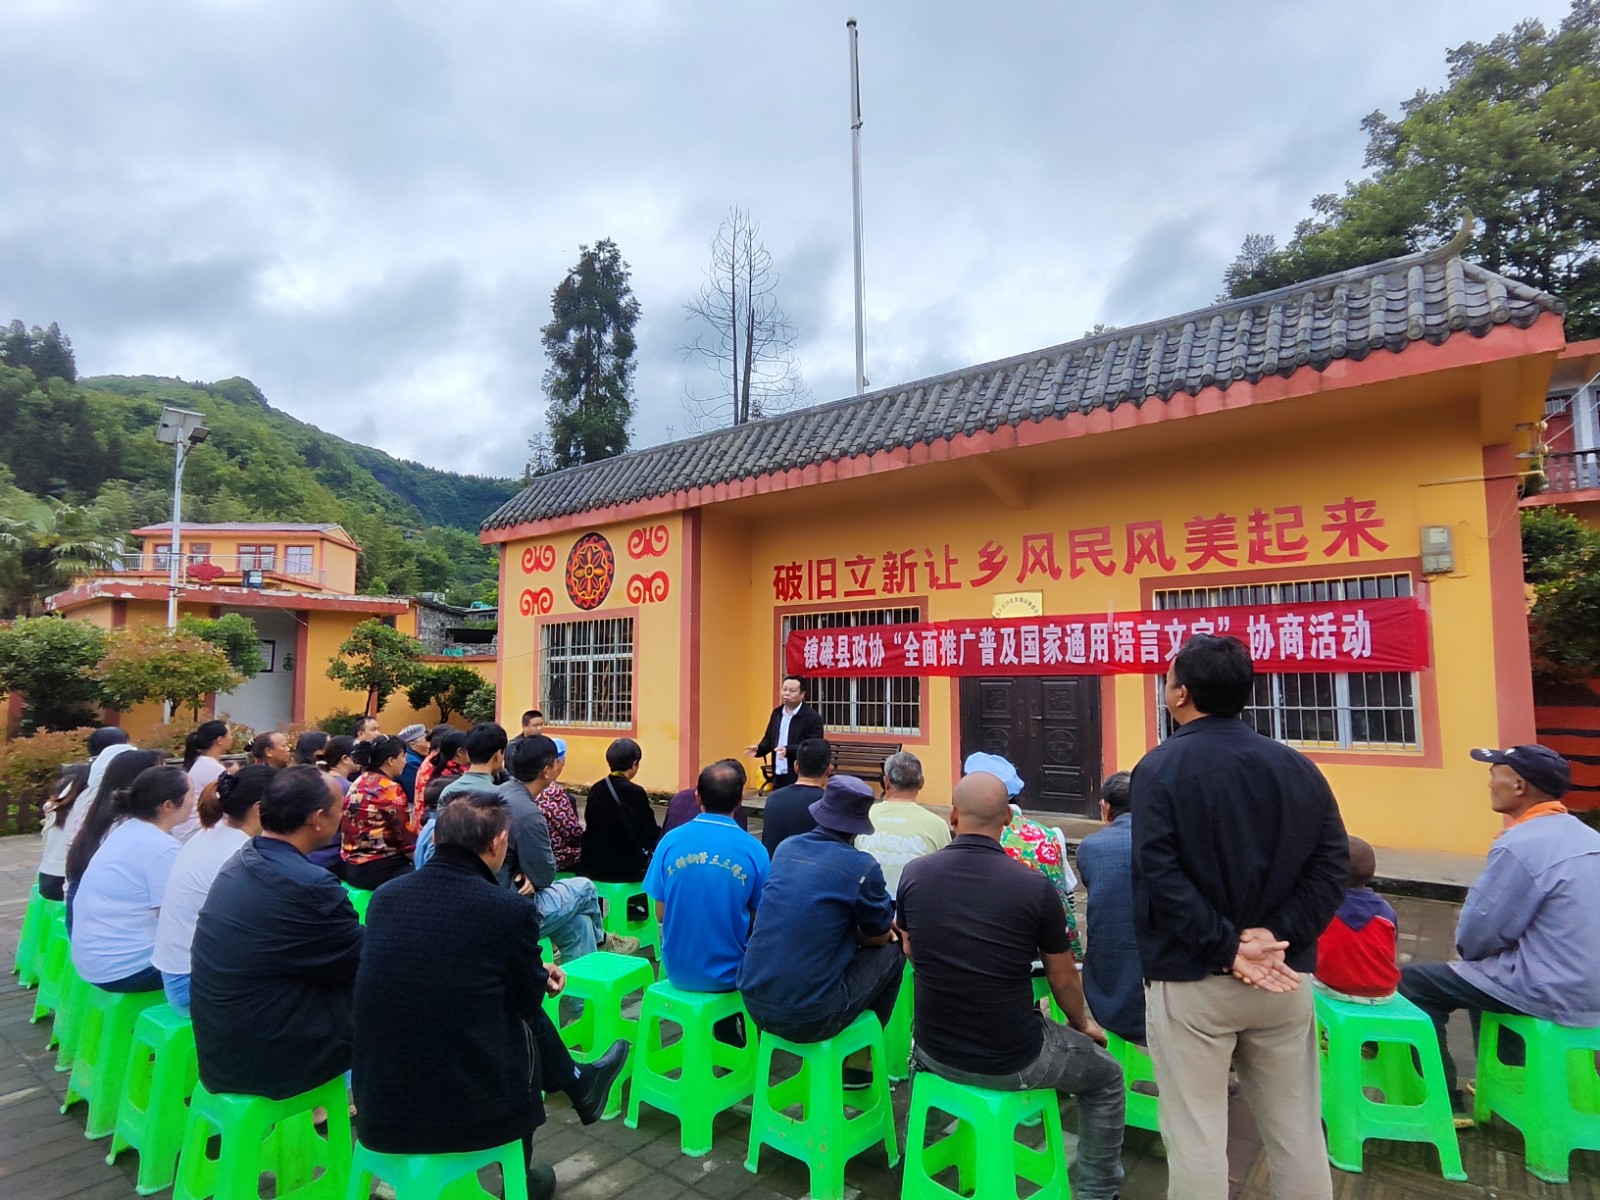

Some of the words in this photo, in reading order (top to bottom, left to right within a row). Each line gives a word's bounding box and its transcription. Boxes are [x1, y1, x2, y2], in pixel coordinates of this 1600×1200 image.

[773, 496, 1390, 602] 破旧立新让乡风民风美起来
